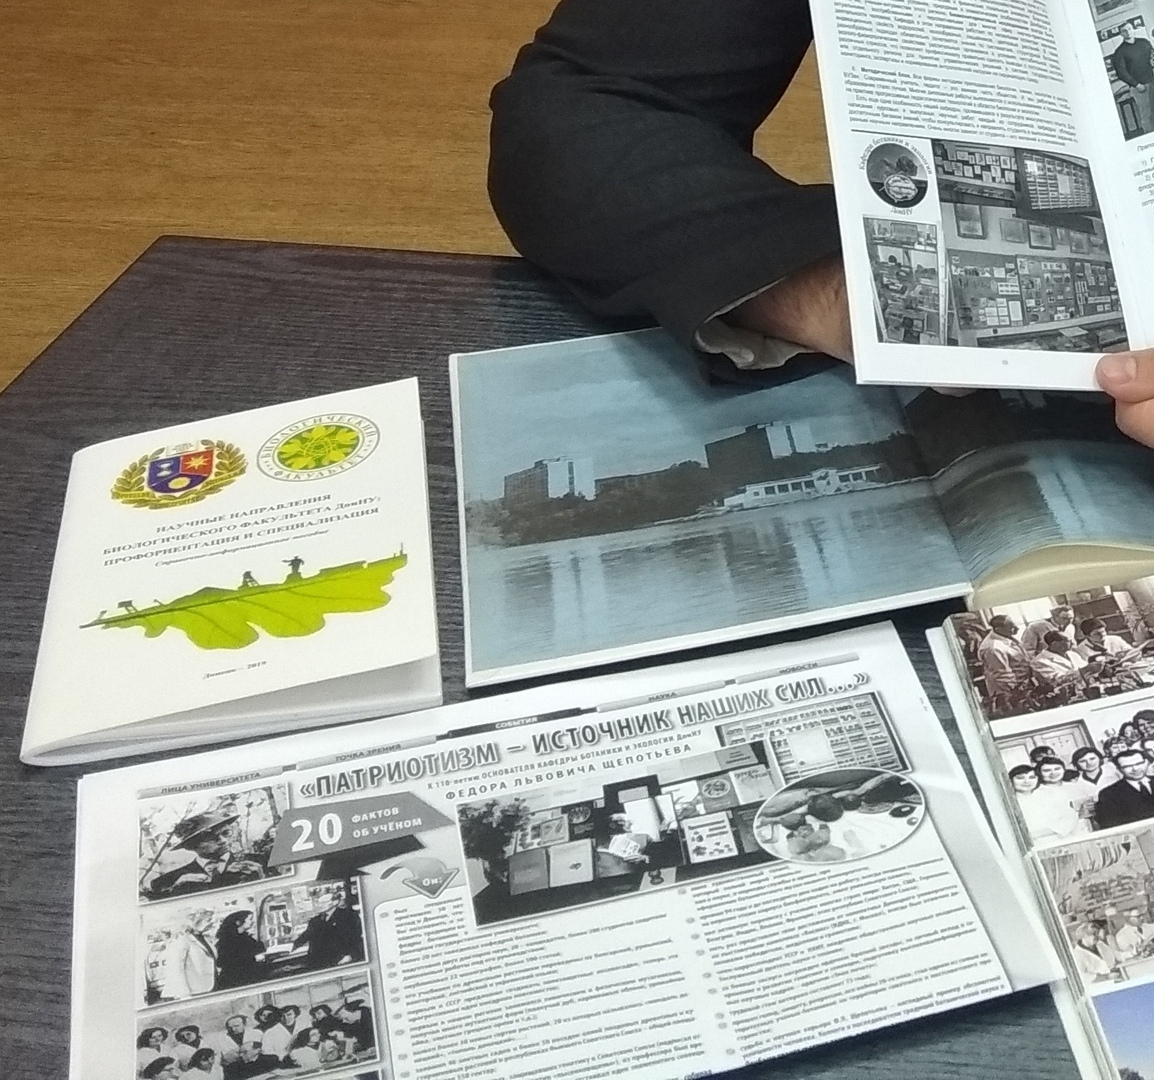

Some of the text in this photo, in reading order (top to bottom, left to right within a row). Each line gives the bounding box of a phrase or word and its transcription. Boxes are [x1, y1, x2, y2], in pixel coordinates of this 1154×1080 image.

[103, 525, 237, 555] БИОЛОГИЧЕСКОГО
[240, 506, 331, 528] ФАКУЛЬТЕТА
[156, 494, 331, 533] НАУЧНЫЕ НАПРАВЛЕНИЯ
[104, 535, 239, 566] ПРОФОРИЕНТАЦИЯ
[256, 507, 378, 536] СПЕЦИАЛИЗАЦИЯ
[778, 662, 819, 675] НОВОСТИ
[648, 691, 677, 703] НАУКА
[495, 716, 538, 730] СОБЫТИЯ
[300, 743, 500, 798] «ПАТРИОТИЗМ
[532, 710, 672, 753] ИСТОЧНИК
[676, 689, 771, 725] НАШИХ
[335, 744, 402, 763] ТОЧКА ЗРЕНИЯ
[481, 763, 535, 779] ОСНОВАТЕЛЯ
[537, 755, 578, 768] КАФЕДРЫ
[580, 747, 621, 760] БОТАНИКИ
[633, 736, 674, 750] ЭКОЛОГИИ
[161, 772, 261, 795] ЛИЦА УНИВЕРСИТЕТА
[445, 744, 691, 800] ФЕДОРА ЛЬВОВИЧА ЩЕПОТЬЕВА
[290, 805, 399, 853] 20 ФАКТОВ
[353, 814, 421, 839] ОБ УЧЁНОМ
